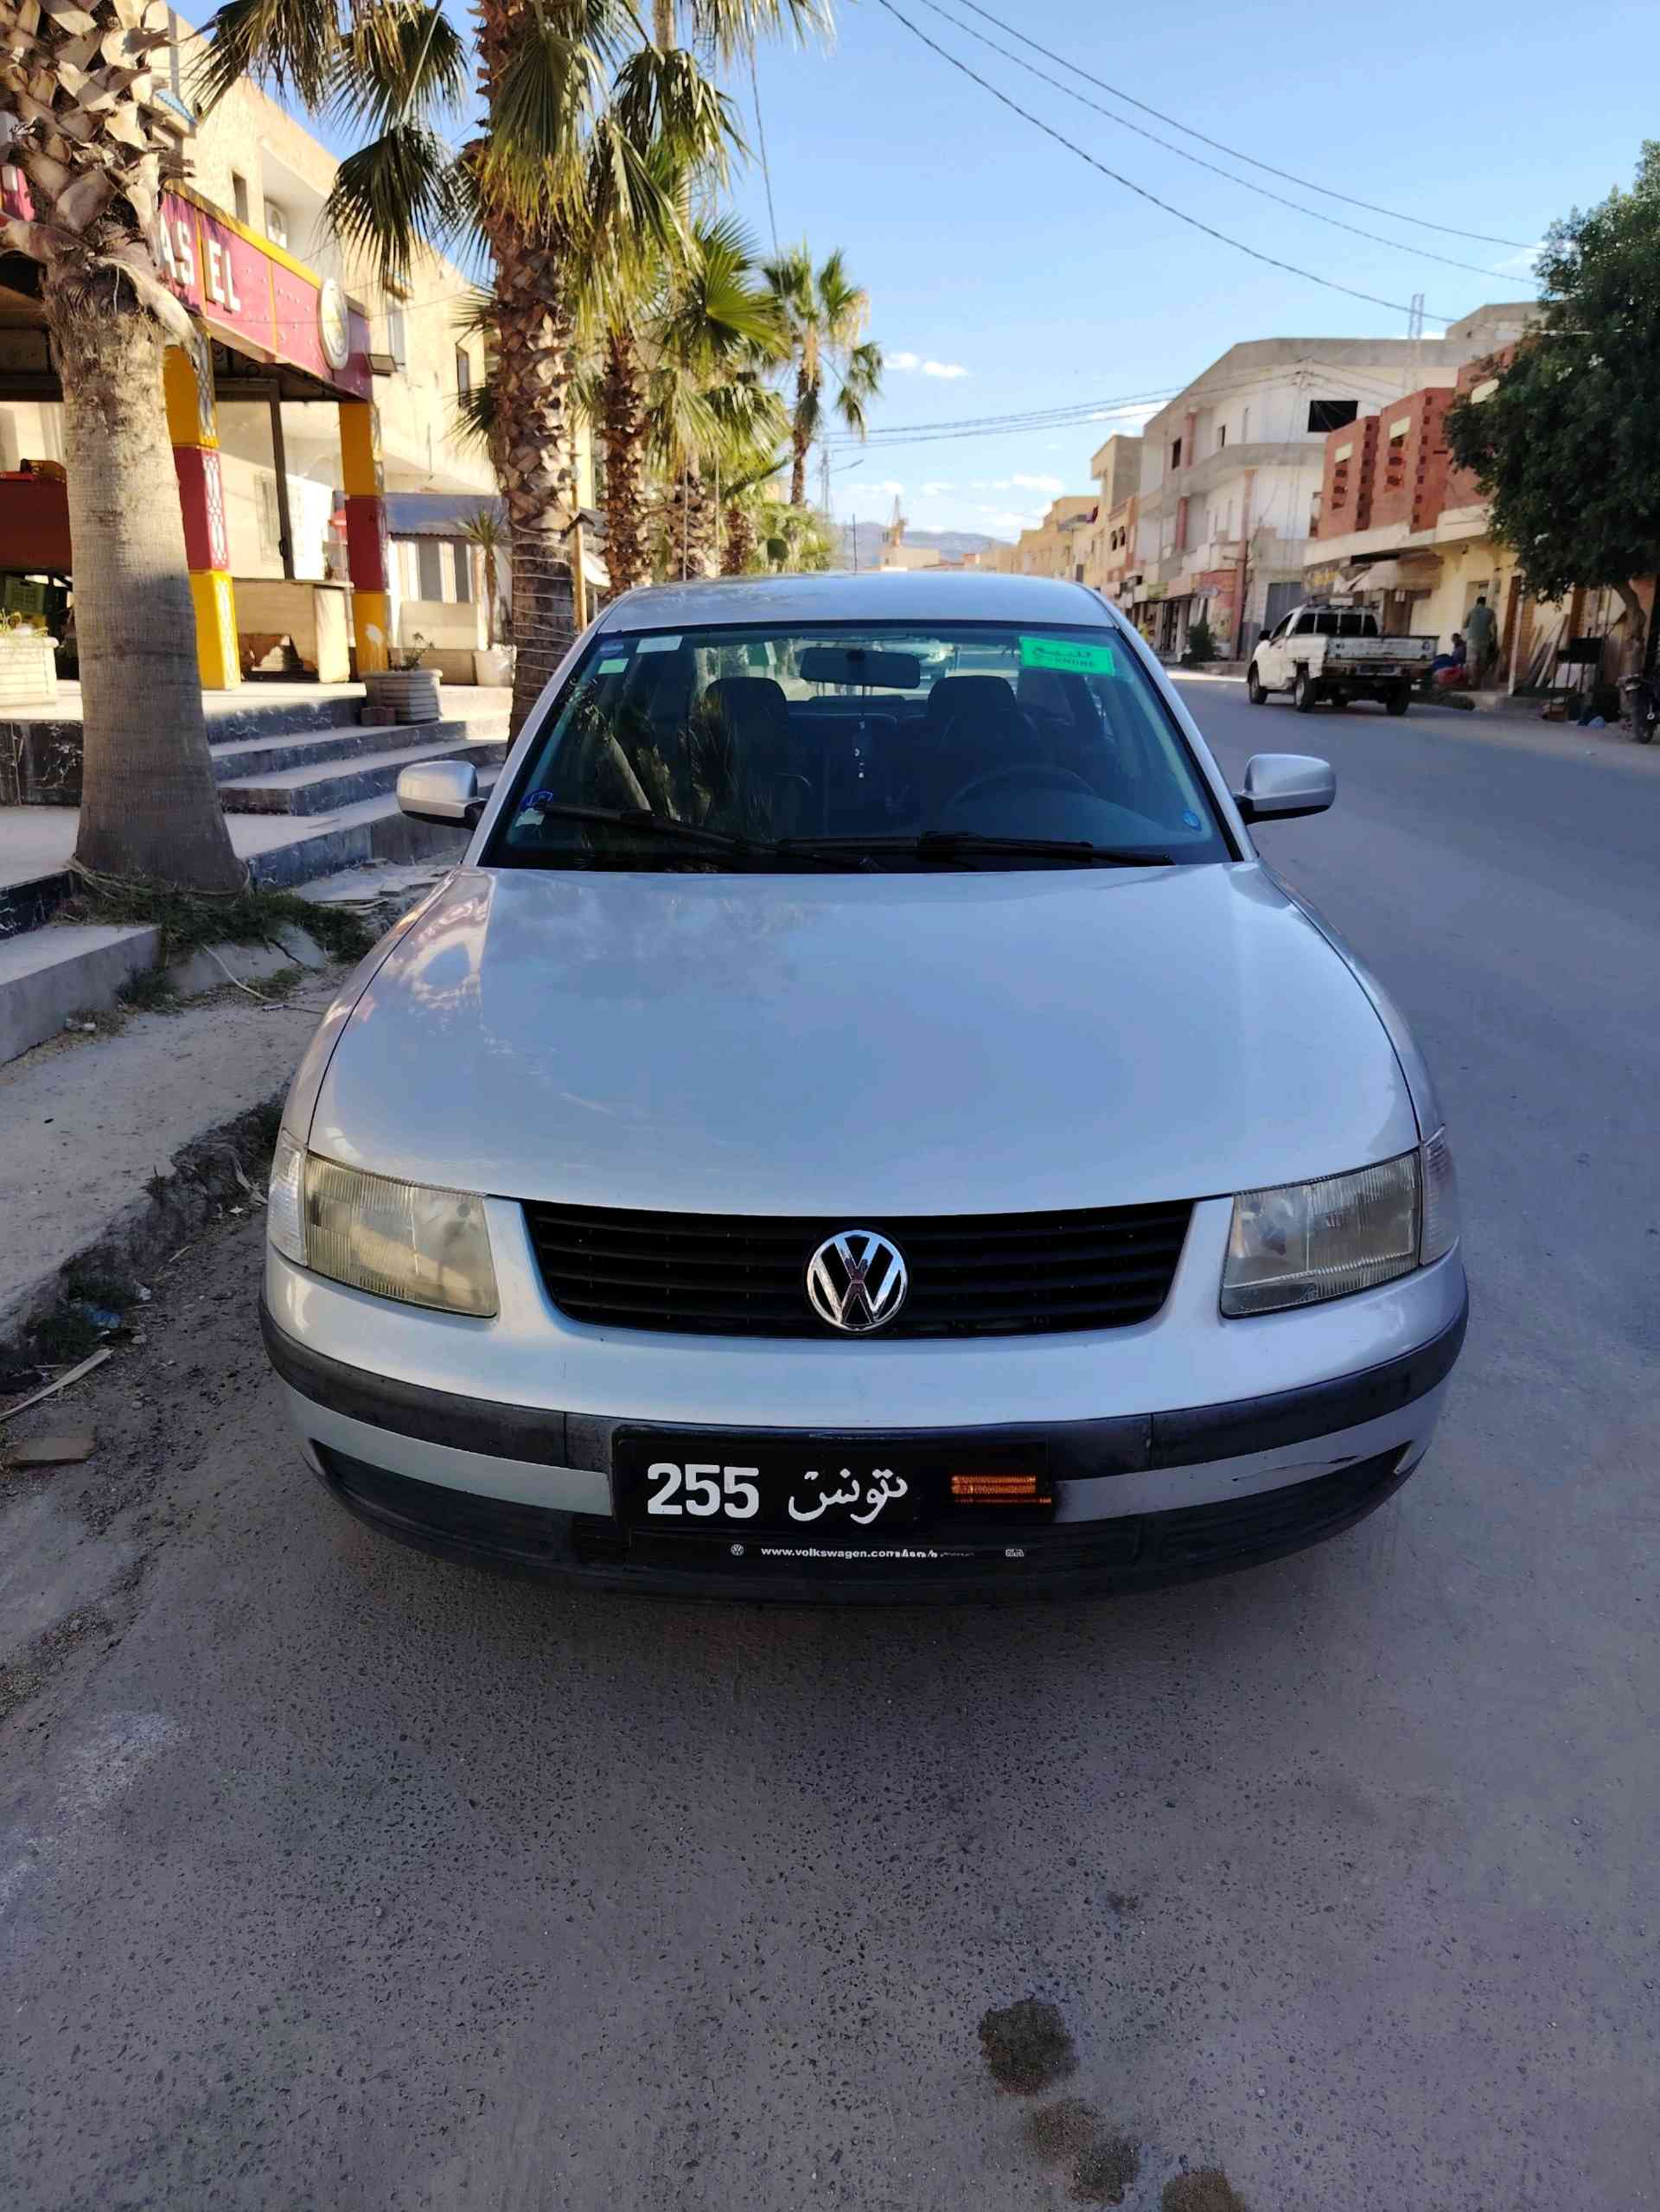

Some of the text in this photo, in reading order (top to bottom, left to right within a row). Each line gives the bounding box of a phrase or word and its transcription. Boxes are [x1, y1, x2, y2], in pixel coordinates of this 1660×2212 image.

[207, 238, 241, 312] EL
[647, 1463, 759, 1519] 255
[788, 1468, 908, 1525] تونس
